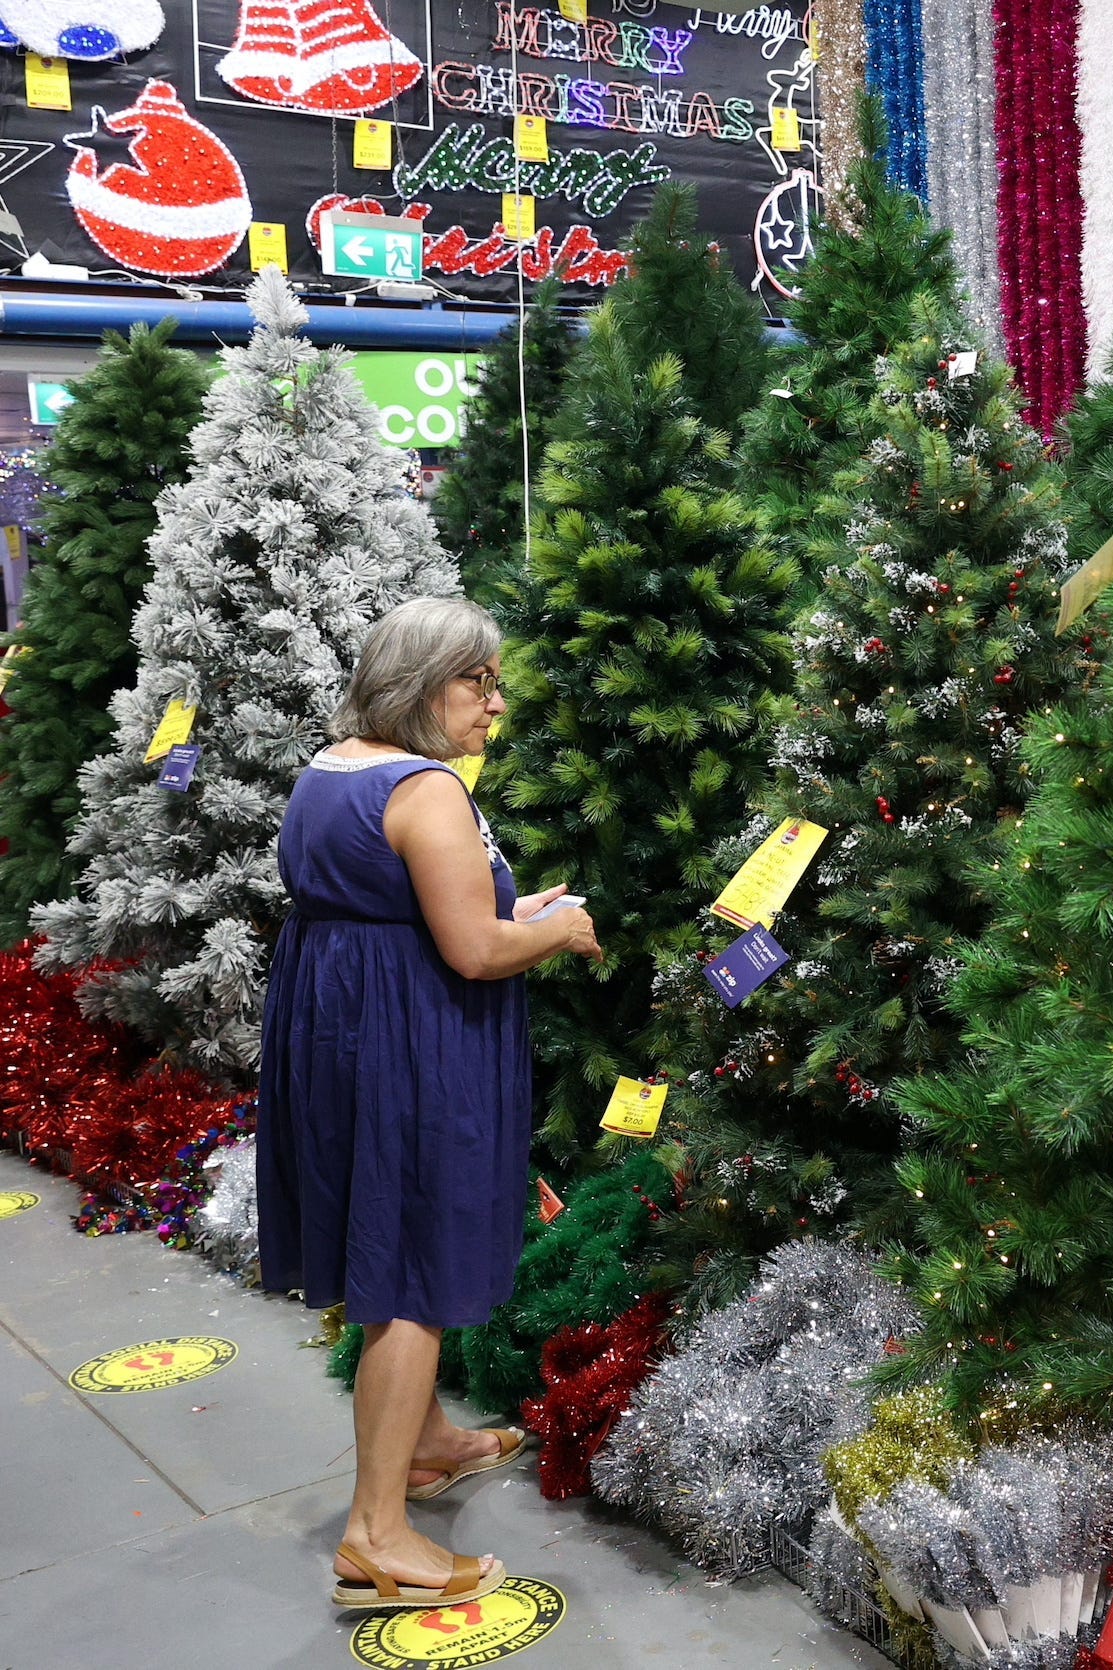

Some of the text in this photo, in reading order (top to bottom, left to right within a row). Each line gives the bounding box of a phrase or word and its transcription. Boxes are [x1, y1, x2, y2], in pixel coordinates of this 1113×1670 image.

[492, 3, 692, 74] MERRY
[432, 61, 754, 140] CHRISTMAS
[725, 974, 737, 987] zip
[623, 1116, 644, 1126] $7.00
[99, 1340, 171, 1360] SOCIAL
[120, 1378, 180, 1392] STAND
[357, 1578, 558, 1669] MAINTAIN STANCE
[425, 1631, 488, 1656] REMAIN
[426, 1622, 551, 1670] STAND HERE
[460, 1631, 508, 1652] APART
